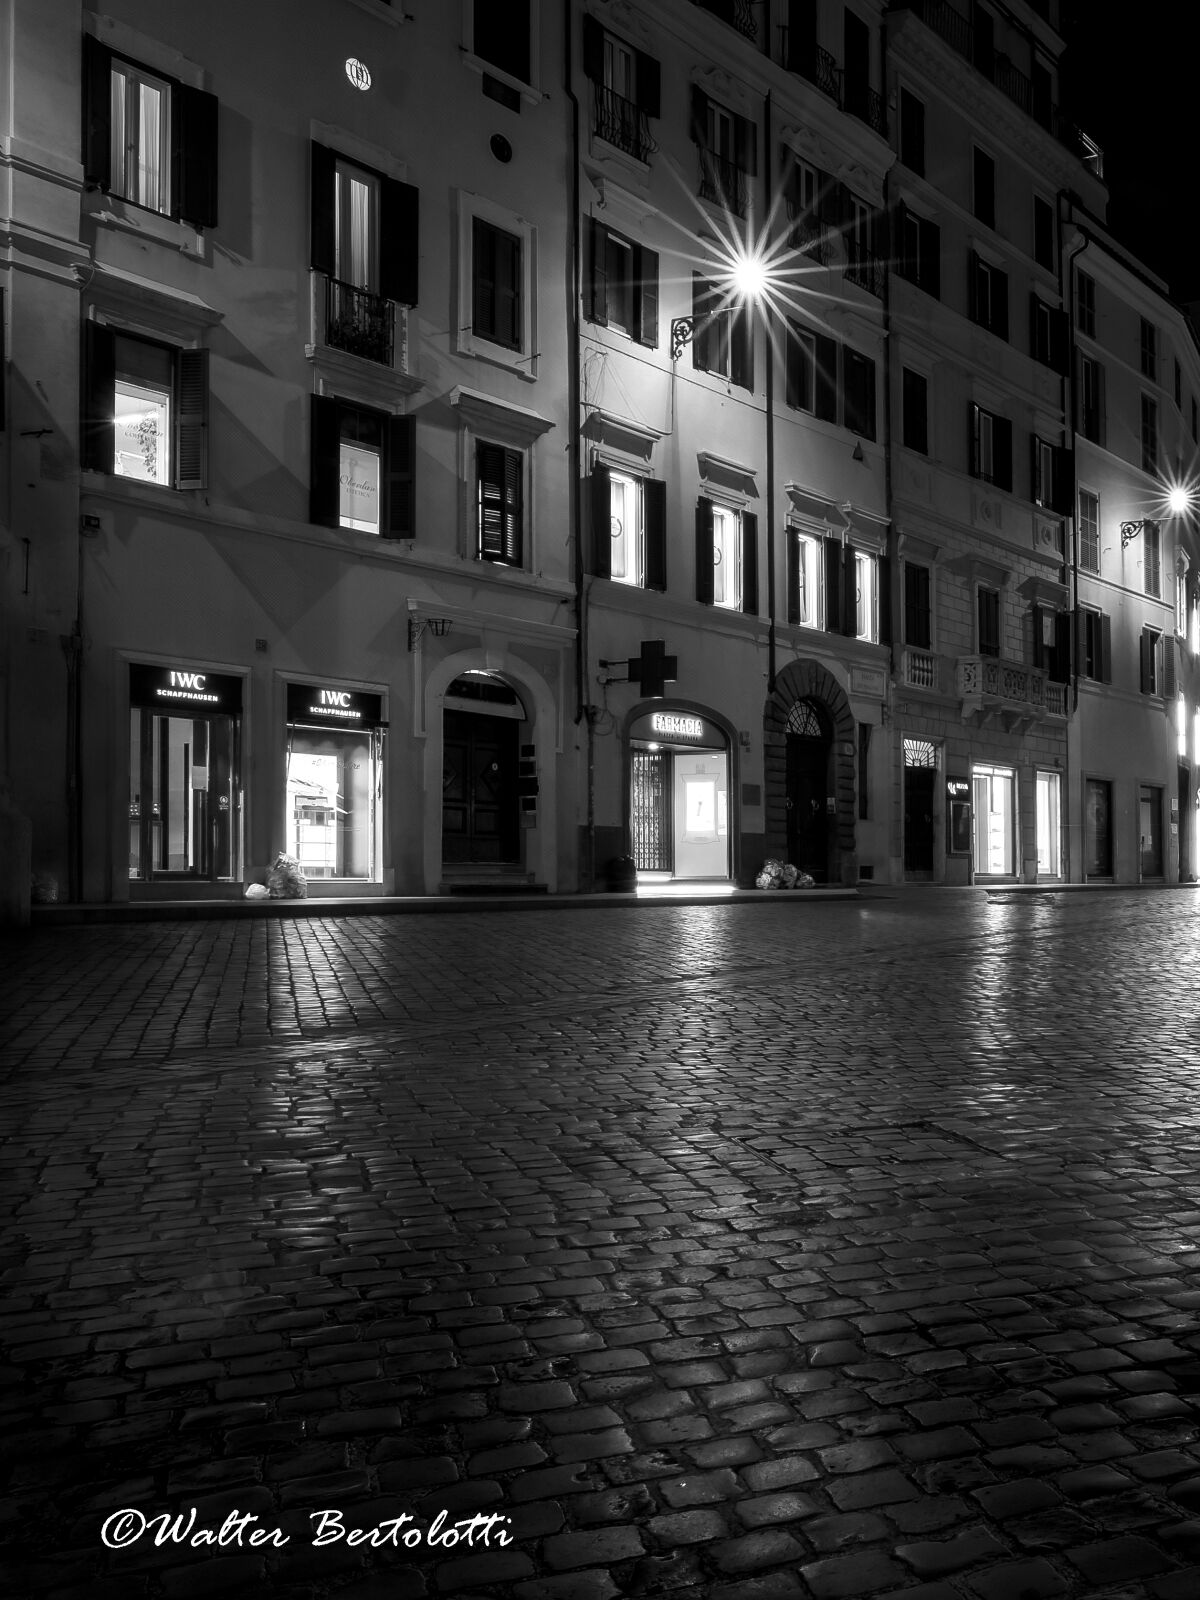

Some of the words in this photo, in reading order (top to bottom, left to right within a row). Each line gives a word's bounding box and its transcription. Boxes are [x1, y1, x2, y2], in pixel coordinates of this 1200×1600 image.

[170, 671, 206, 690] IWC
[156, 688, 219, 702] SCHAFFHAUSEN
[321, 690, 351, 708] IWC
[309, 706, 361, 718] SCHAFFHAUSEN
[654, 714, 704, 735] FARMACIA
